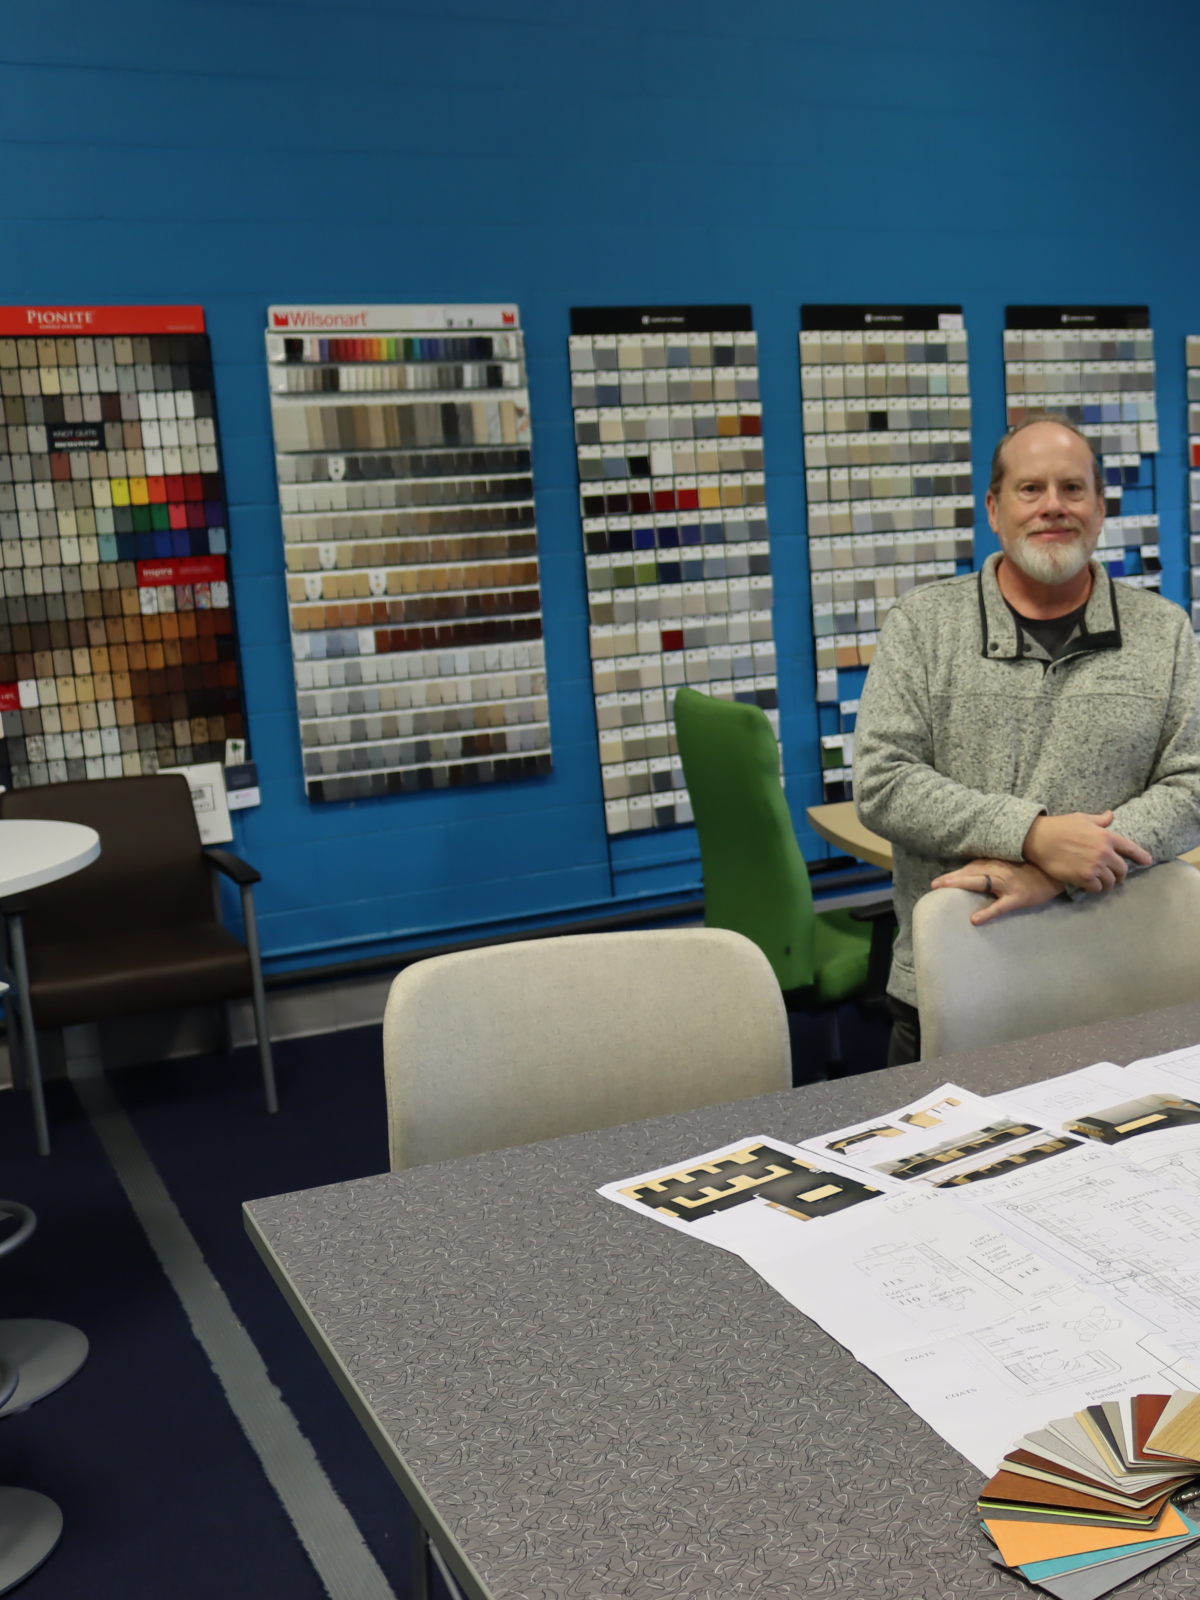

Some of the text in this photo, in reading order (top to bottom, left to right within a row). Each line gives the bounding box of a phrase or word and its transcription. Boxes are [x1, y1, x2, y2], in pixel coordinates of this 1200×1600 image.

[26, 309, 94, 325] PIONITE
[289, 311, 368, 327] Wilsonart
[904, 1351, 936, 1362] COATS
[1026, 1353, 1043, 1361] Help
[1085, 1374, 1151, 1397] Relocated Library
[945, 1388, 978, 1400] COATS
[1090, 1388, 1127, 1401] Furniture
